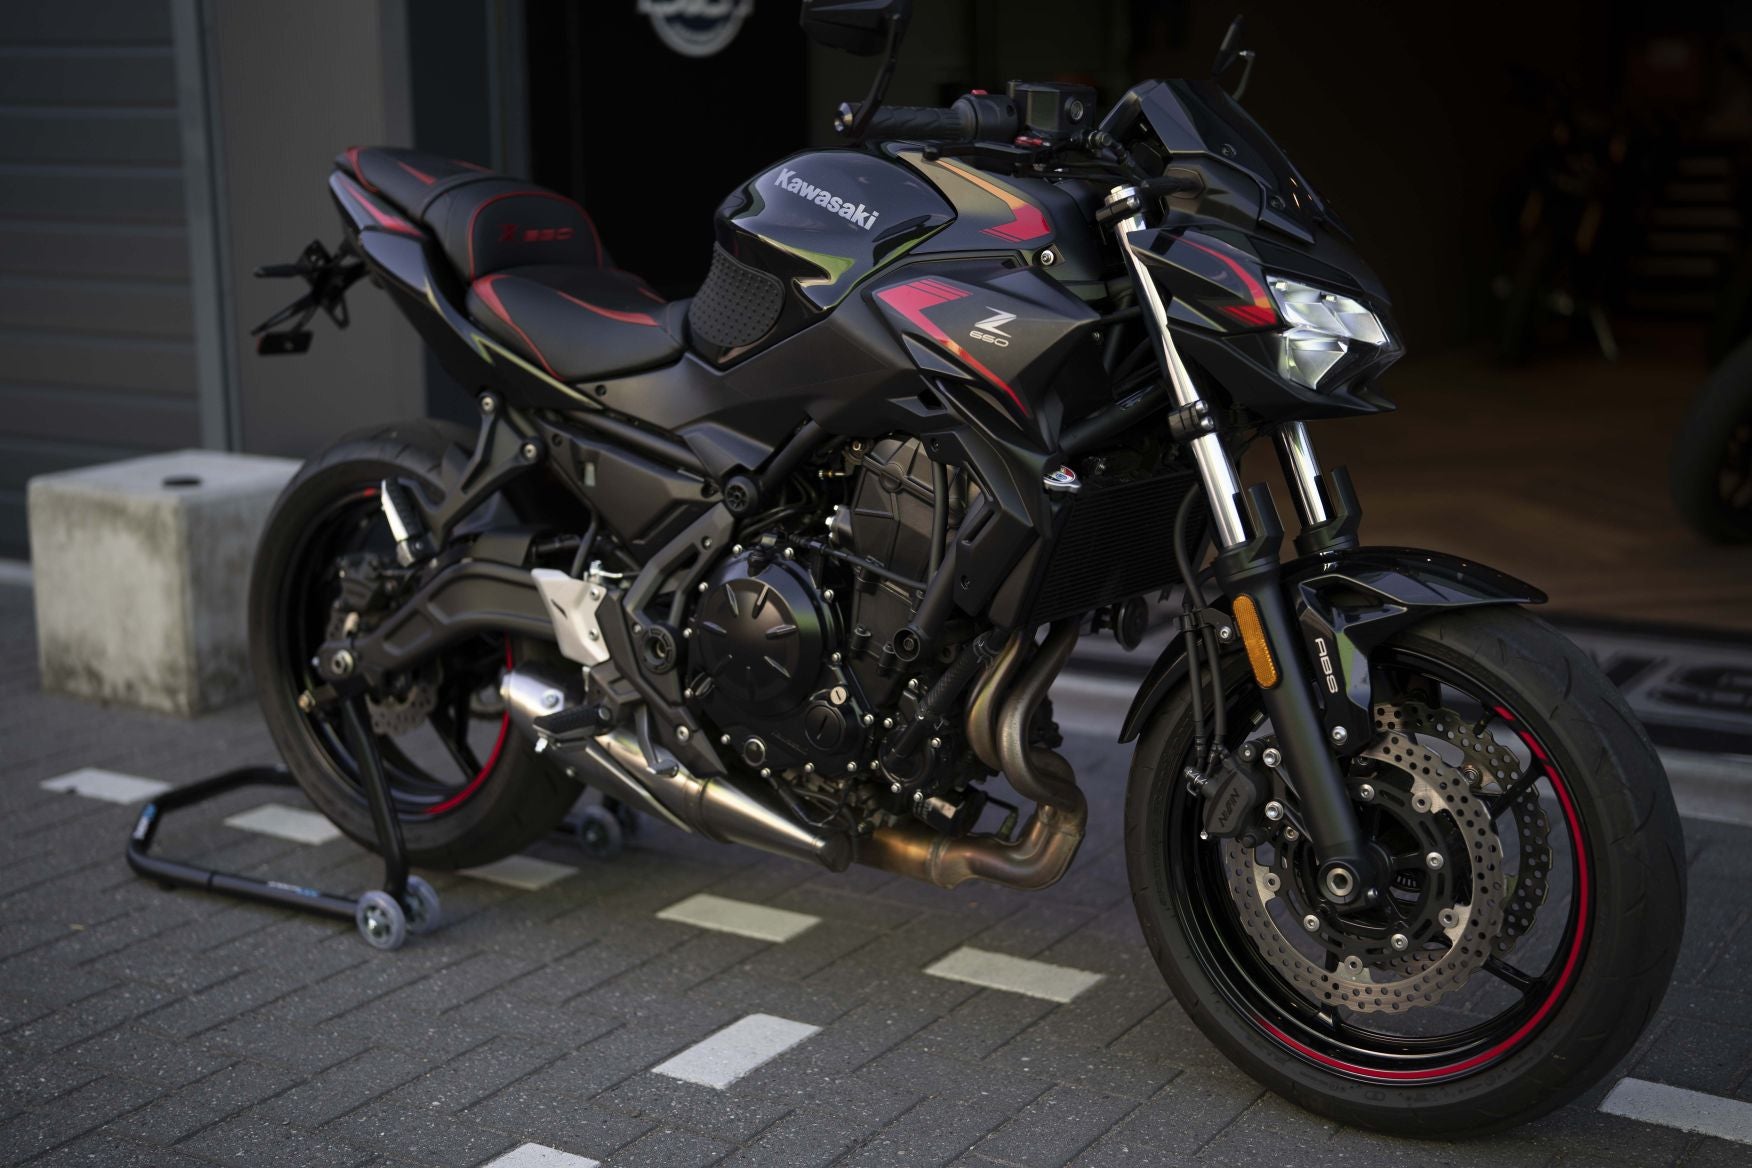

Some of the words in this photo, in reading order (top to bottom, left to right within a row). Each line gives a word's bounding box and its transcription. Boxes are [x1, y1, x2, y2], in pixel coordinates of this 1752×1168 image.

[774, 168, 880, 231] Kawasaki
[969, 330, 1009, 347] 650
[974, 305, 1017, 338] Z
[1314, 637, 1339, 694] ABS
